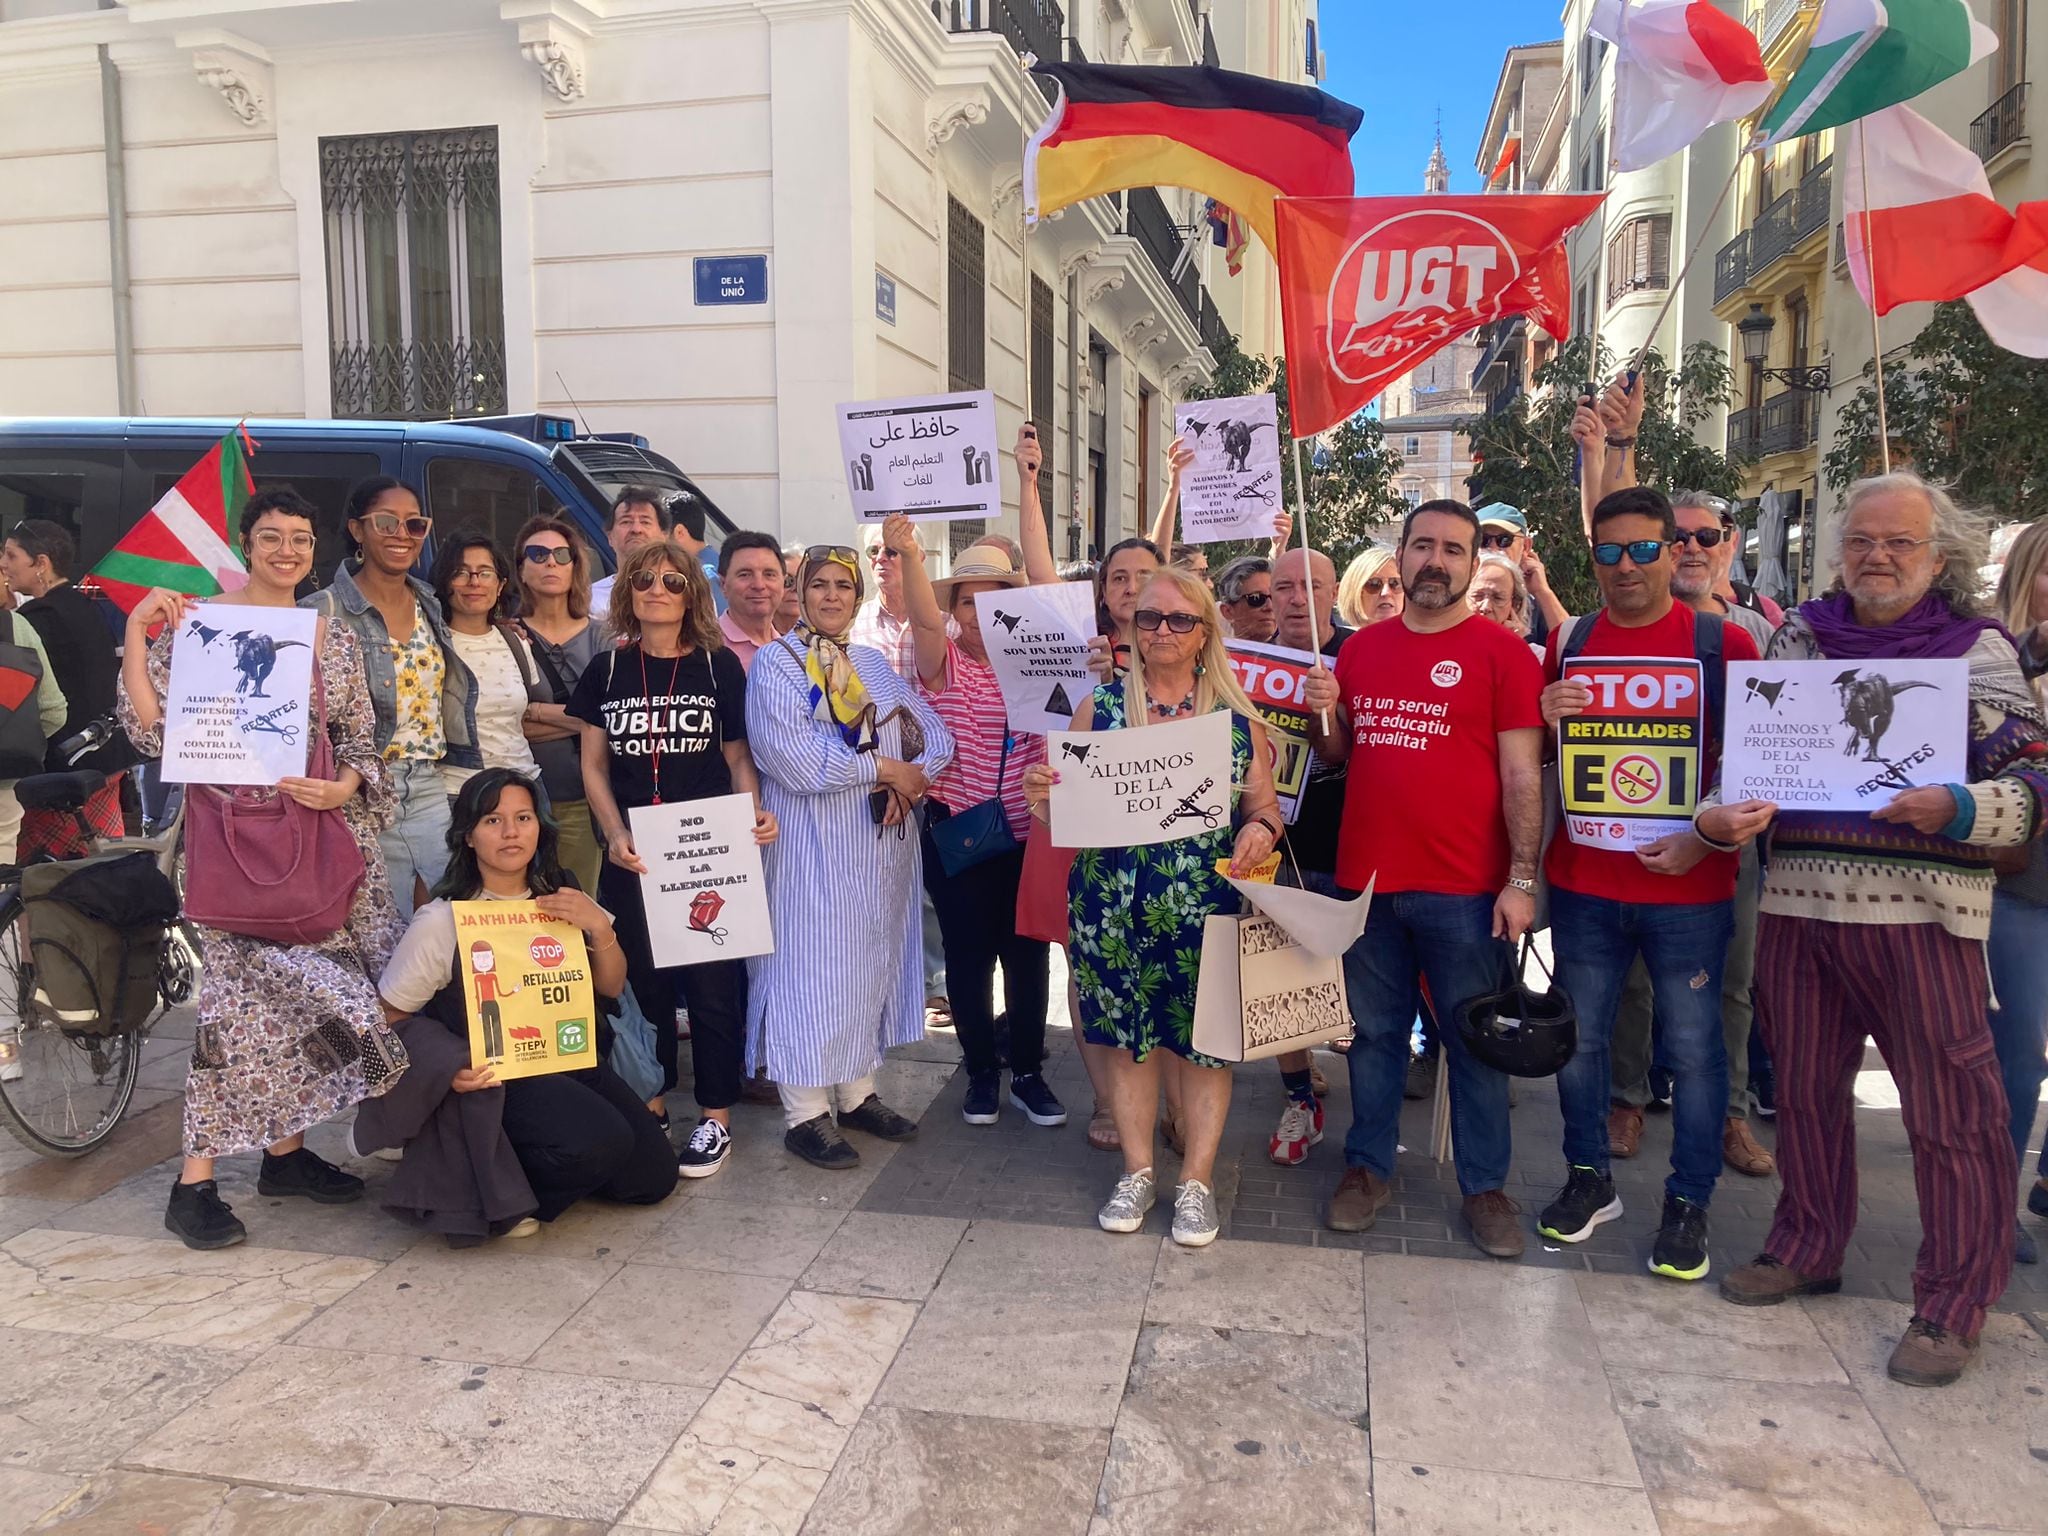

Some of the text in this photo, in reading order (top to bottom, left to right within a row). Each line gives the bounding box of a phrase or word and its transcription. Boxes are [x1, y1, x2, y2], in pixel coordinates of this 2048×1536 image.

[734, 276, 744, 284] LA
[1354, 245, 1496, 326] UGT
[721, 285, 745, 297] UNIÓ
[870, 416, 960, 448] حافظ على
[889, 452, 944, 473] التعليم العام
[1020, 632, 1065, 643] LES EOI
[1003, 648, 1027, 656] SON
[1030, 658, 1072, 666] PUBLIC
[1020, 670, 1086, 679] NECESSARI!
[1435, 664, 1459, 677] UGT
[1568, 674, 1694, 709] STOP
[186, 696, 236, 704] ALUMNOS
[622, 697, 649, 709] UNA
[652, 695, 716, 708] EDUCACIÓ
[1364, 697, 1372, 708] a
[1376, 698, 1394, 710] un
[1397, 699, 1448, 717] servei
[182, 707, 248, 716] PROFESORES
[240, 700, 298, 734] RECORTES
[1381, 714, 1451, 736] educatiu
[1568, 722, 1692, 740] RETALLADES
[1747, 723, 1832, 734] ALUMNOS Y
[184, 740, 226, 748] CONTRA
[625, 738, 710, 756] QUALITAT
[1357, 730, 1428, 750] de qualitat
[1744, 736, 1835, 748] PROFESORES
[1762, 751, 1810, 761] DE LAS
[1090, 752, 1194, 778] ALUMNOS
[1775, 764, 1799, 774] EOI
[1855, 743, 1936, 798] RECORTES
[1114, 776, 1173, 796] DE LA
[1744, 776, 1826, 788] CONTRA LA
[1739, 789, 1832, 801] INVOLUCION
[1126, 796, 1162, 813] EOI
[1159, 777, 1214, 830] RECORTES
[680, 816, 704, 827] NO
[1573, 821, 1605, 837] UGT
[678, 832, 711, 843] ENS
[664, 845, 729, 861] TALLEU
[689, 863, 712, 873] LA
[660, 874, 747, 892] LLENGUA!!
[460, 915, 477, 926] JA
[508, 914, 528, 924] HA
[532, 944, 562, 959] STOP
[523, 969, 584, 986] RETALLADES
[541, 985, 570, 1005] EOI
[514, 1040, 546, 1052] STEPV
